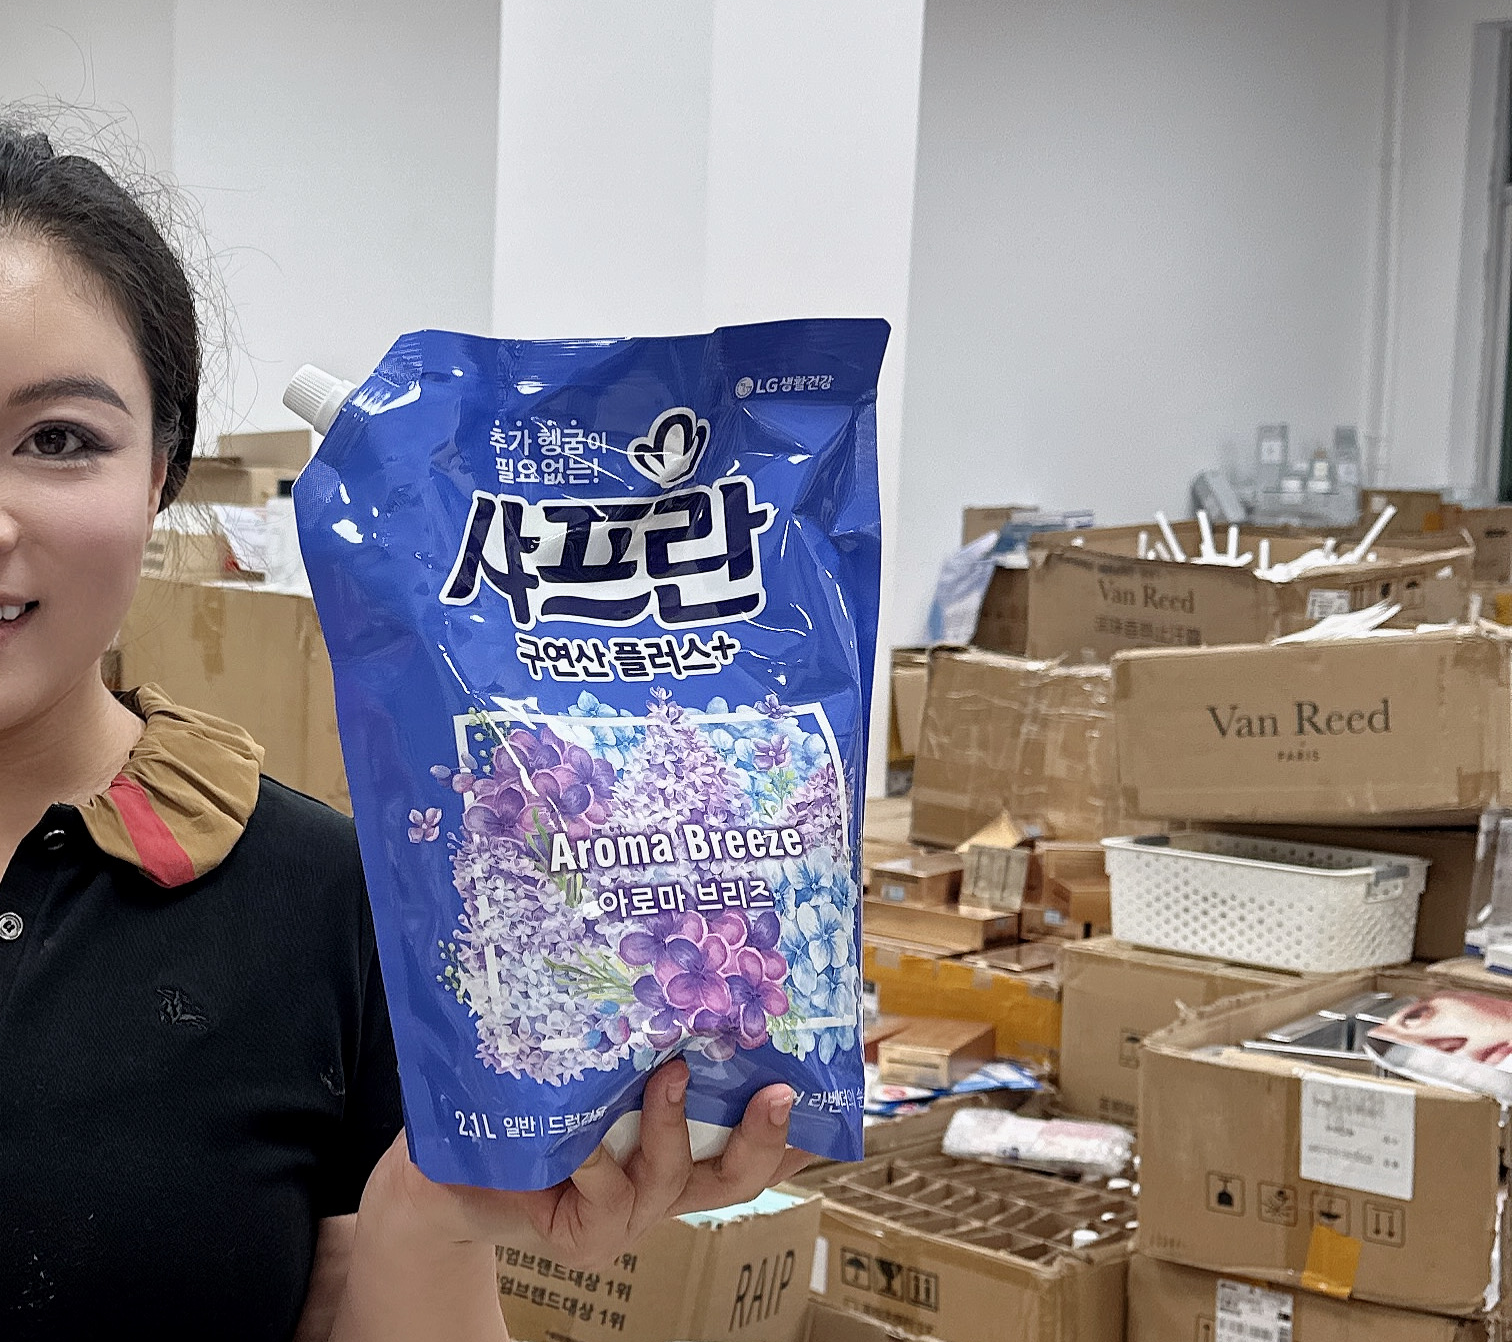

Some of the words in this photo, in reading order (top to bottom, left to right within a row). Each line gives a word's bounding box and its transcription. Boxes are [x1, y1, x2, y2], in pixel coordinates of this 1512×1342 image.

[489, 426, 533, 456] 추가
[537, 426, 607, 456] 헹굼이
[443, 479, 773, 627] 샤프란
[518, 636, 611, 678] 구연산
[1206, 704, 1281, 738] Van
[1294, 696, 1393, 737] Reed
[550, 831, 675, 873] Aroma
[682, 823, 804, 862] Breeze
[598, 884, 687, 918] 아로마
[696, 880, 775, 911] 브리즈
[496, 1274, 594, 1322] 업브랜드대상
